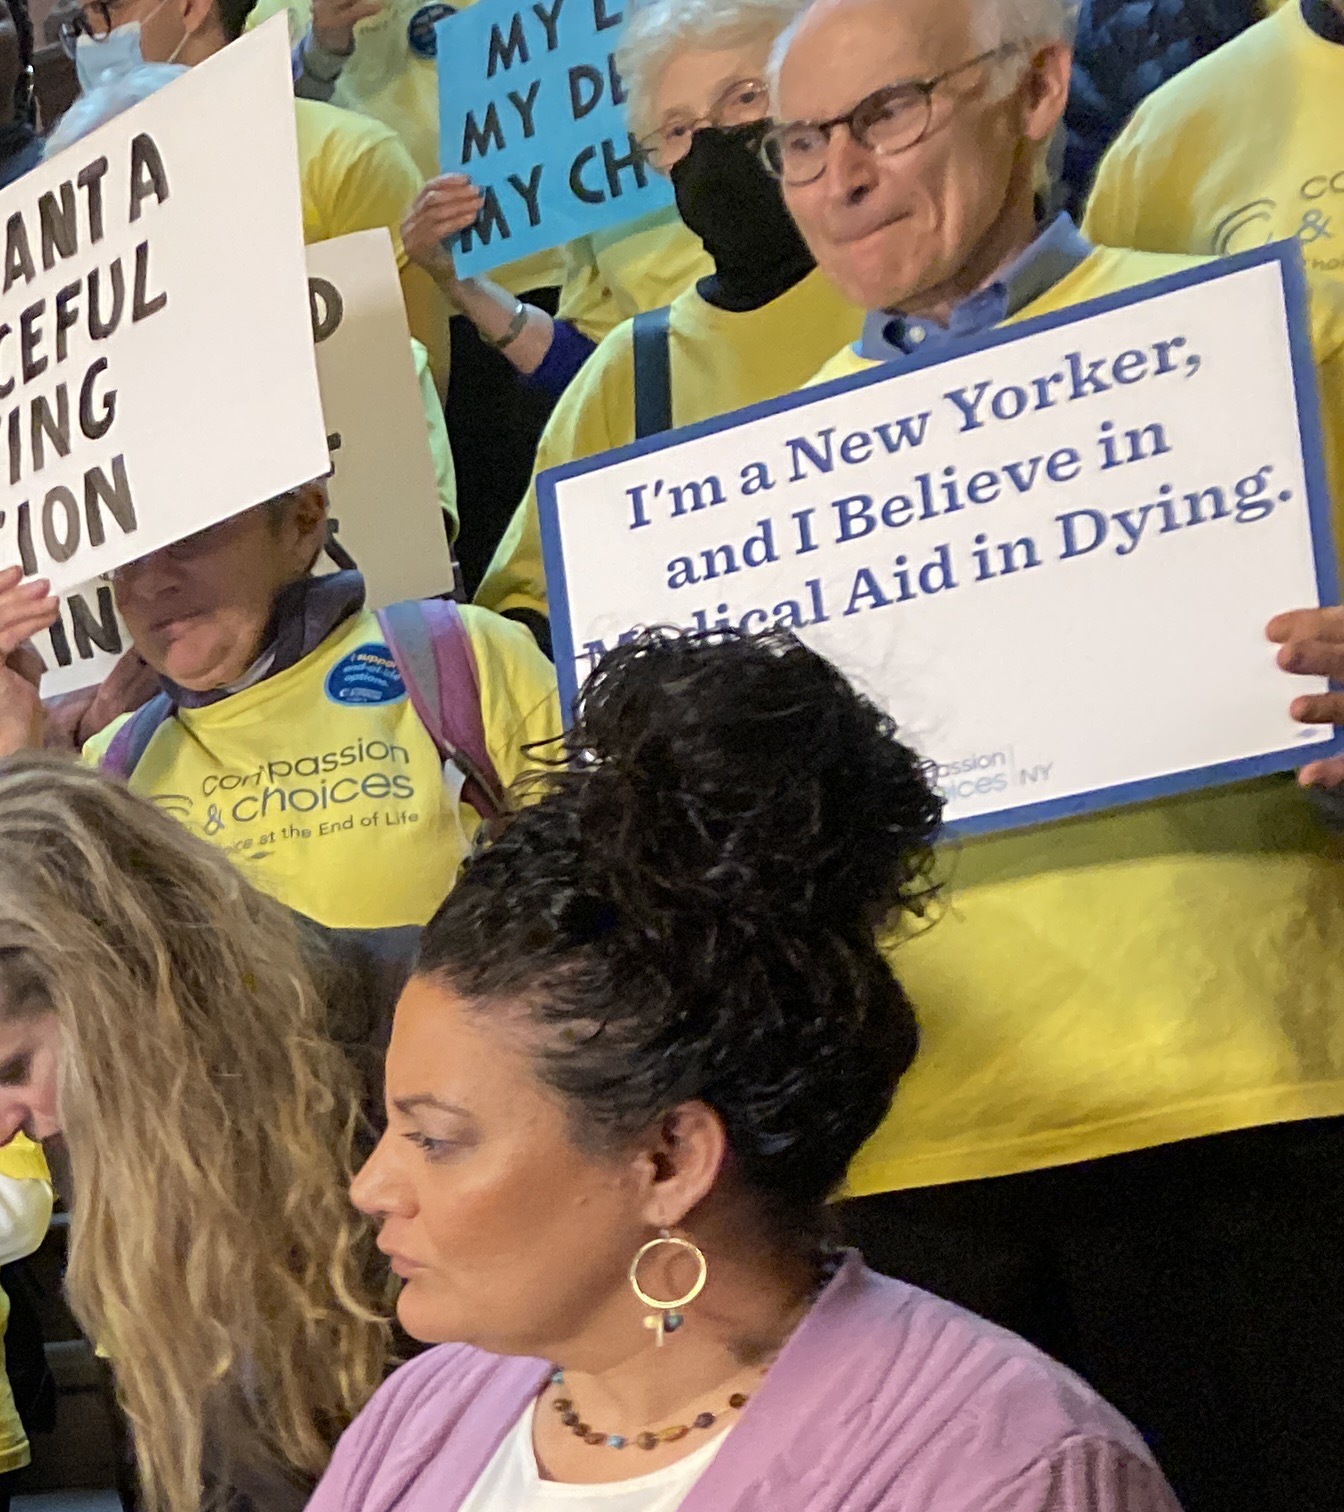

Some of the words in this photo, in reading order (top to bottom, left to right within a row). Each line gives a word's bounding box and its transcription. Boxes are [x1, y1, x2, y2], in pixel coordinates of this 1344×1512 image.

[487, 0, 562, 78] MY
[461, 79, 542, 165] MY
[128, 132, 172, 223] A
[460, 163, 543, 253] MY
[624, 478, 727, 532] I'm
[739, 458, 777, 497] a
[785, 411, 933, 483] New
[943, 334, 1202, 434] Yorker,
[665, 519, 780, 589] and
[793, 508, 818, 556] I
[831, 446, 1082, 544] Believe
[1098, 418, 1173, 471] in
[841, 544, 960, 617] Aid
[972, 533, 1042, 583] in
[1055, 463, 1294, 562] Dying.
[231, 772, 415, 823] choices
[281, 824, 313, 840] the
[318, 813, 355, 837] End
[359, 811, 379, 827] of
[385, 810, 420, 827] Life
